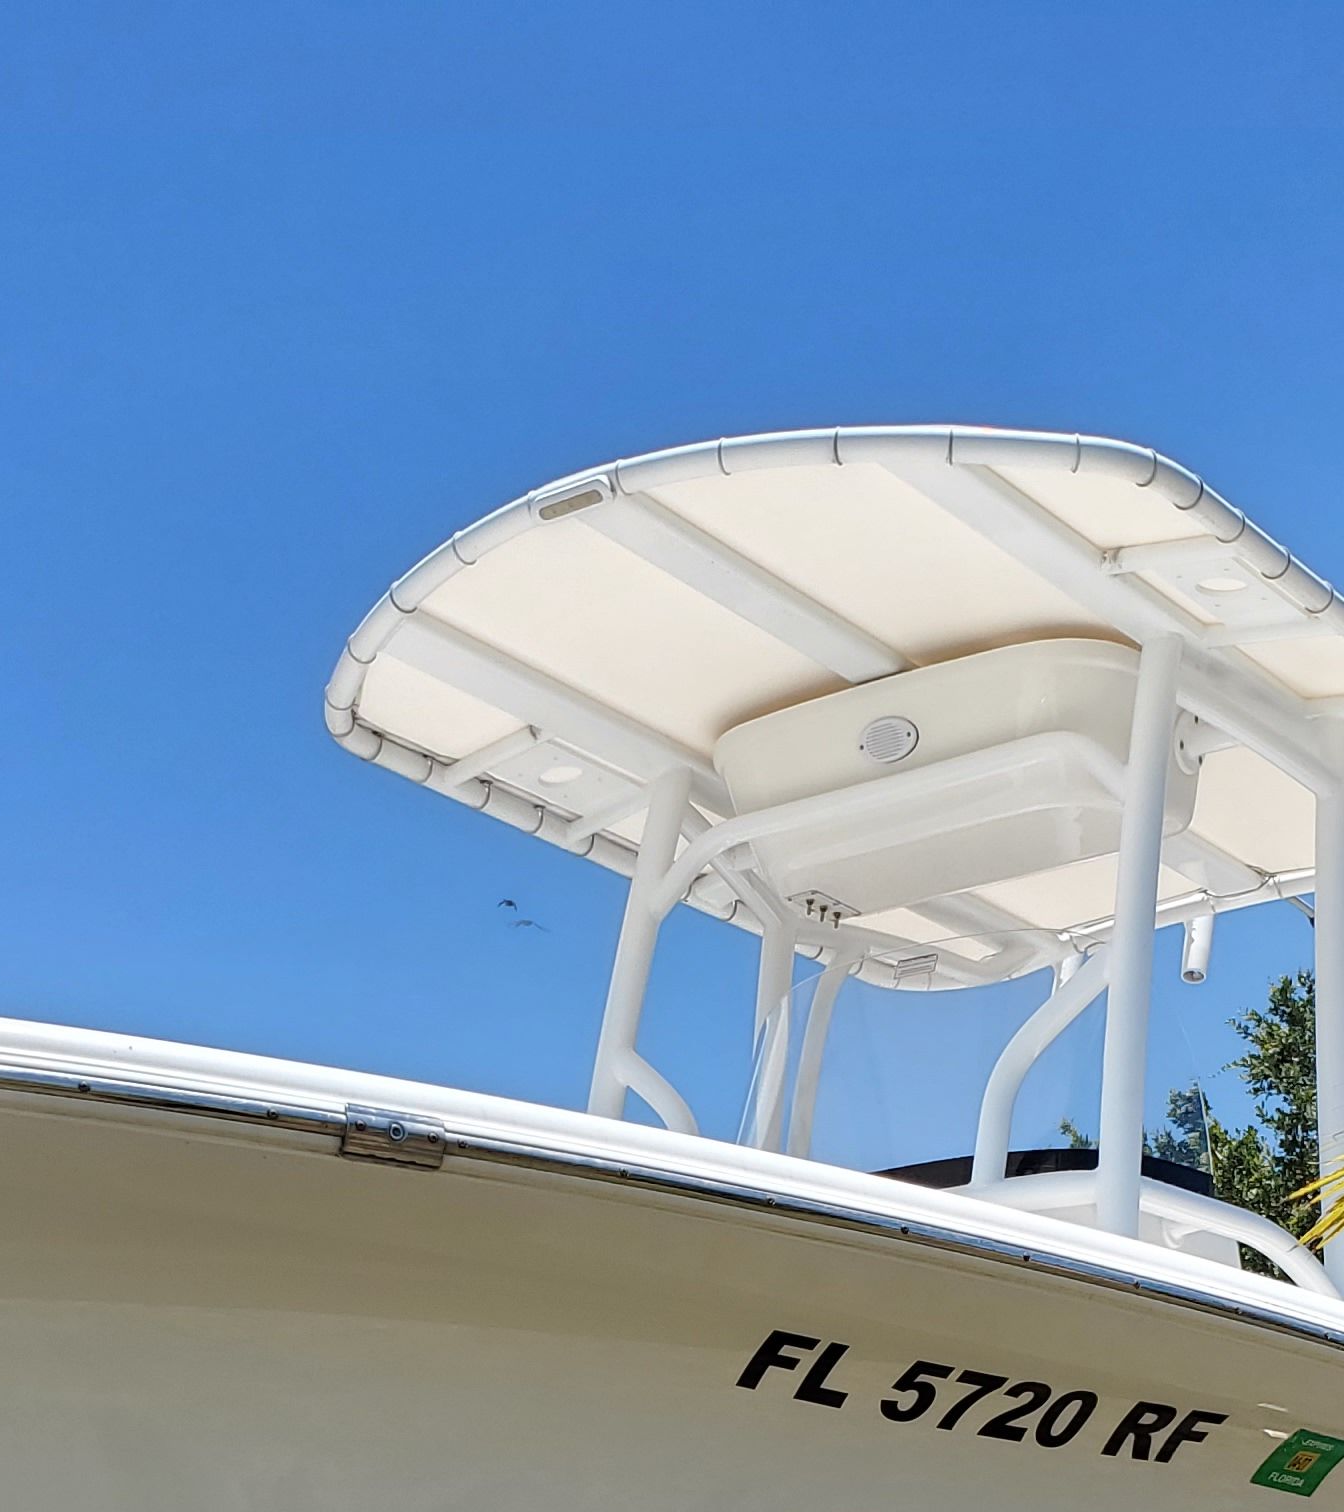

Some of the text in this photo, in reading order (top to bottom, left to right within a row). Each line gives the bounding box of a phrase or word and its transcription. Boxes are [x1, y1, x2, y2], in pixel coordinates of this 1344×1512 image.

[735, 1329, 1230, 1464] FL 5720 RF
